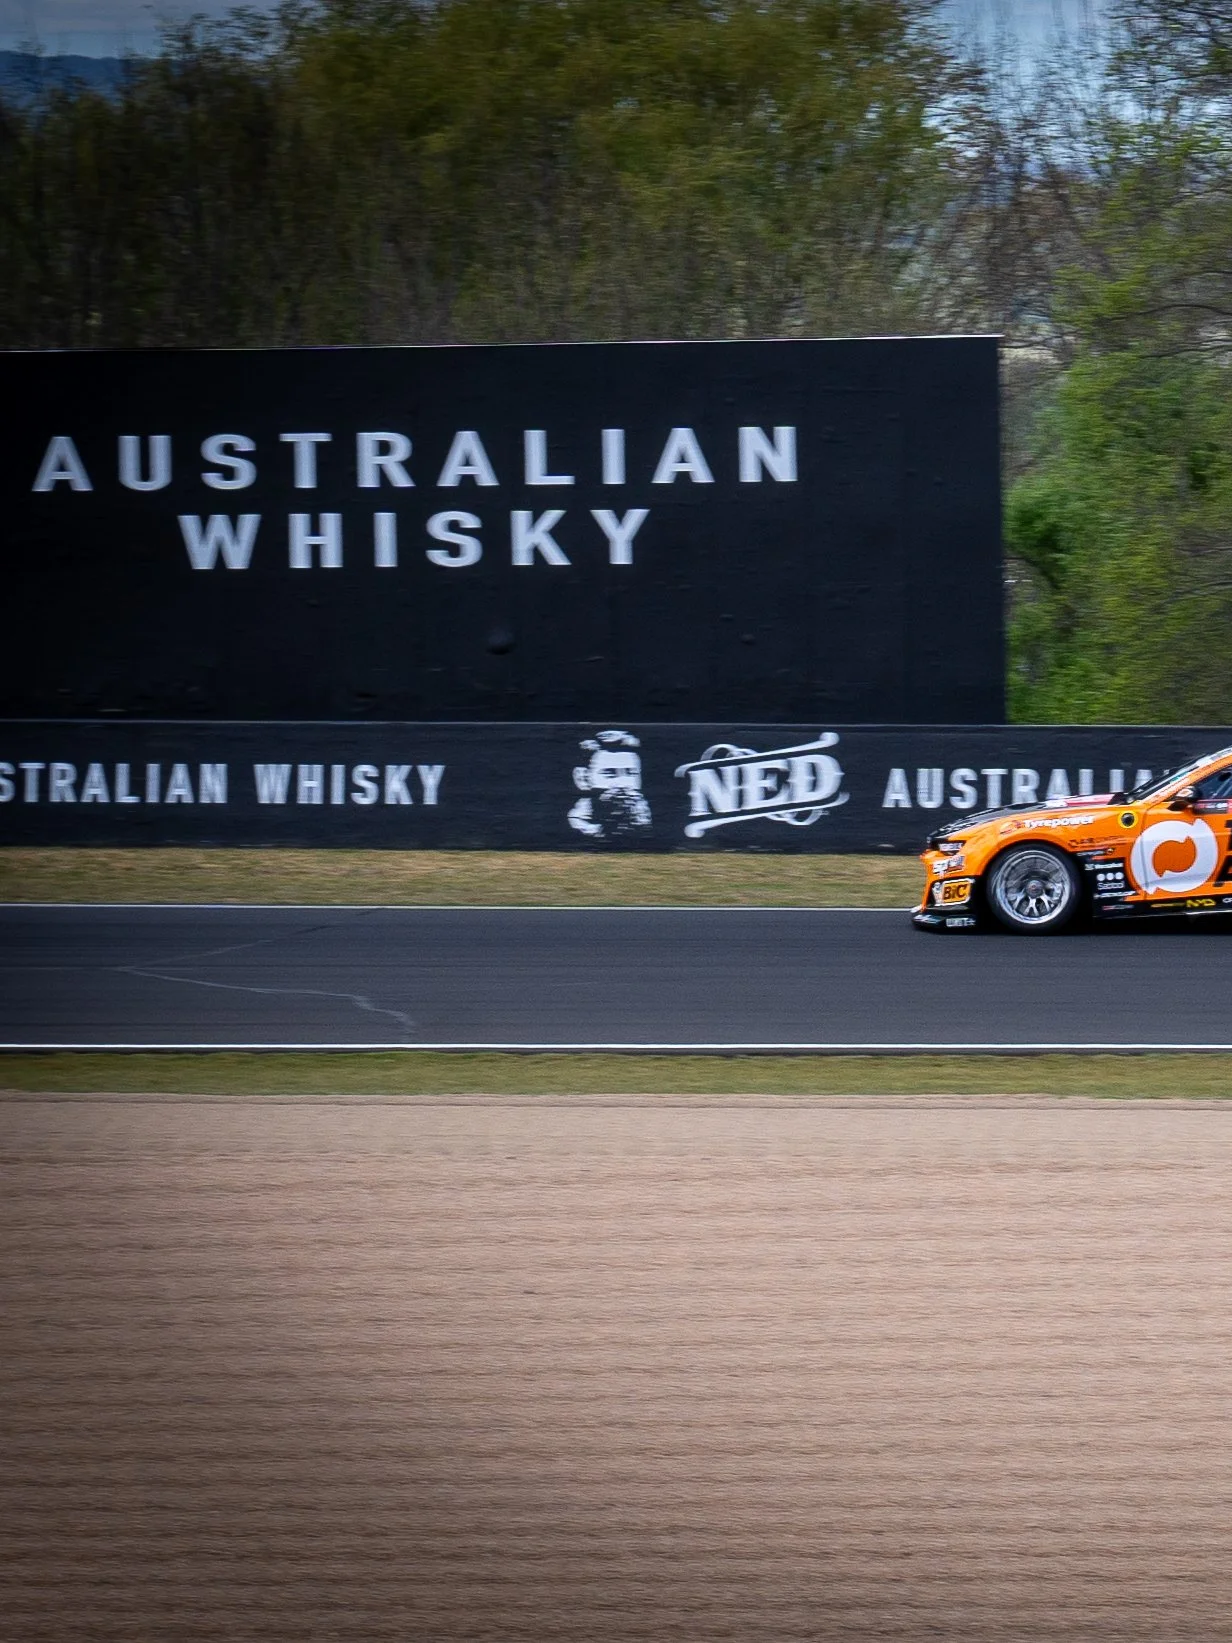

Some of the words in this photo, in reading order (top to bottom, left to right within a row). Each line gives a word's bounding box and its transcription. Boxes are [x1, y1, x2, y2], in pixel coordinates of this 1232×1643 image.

[31, 425, 799, 492] AUSTRALIAN
[178, 508, 651, 570] WHISKY
[254, 763, 446, 806] WHISKY
[687, 751, 847, 818] NED
